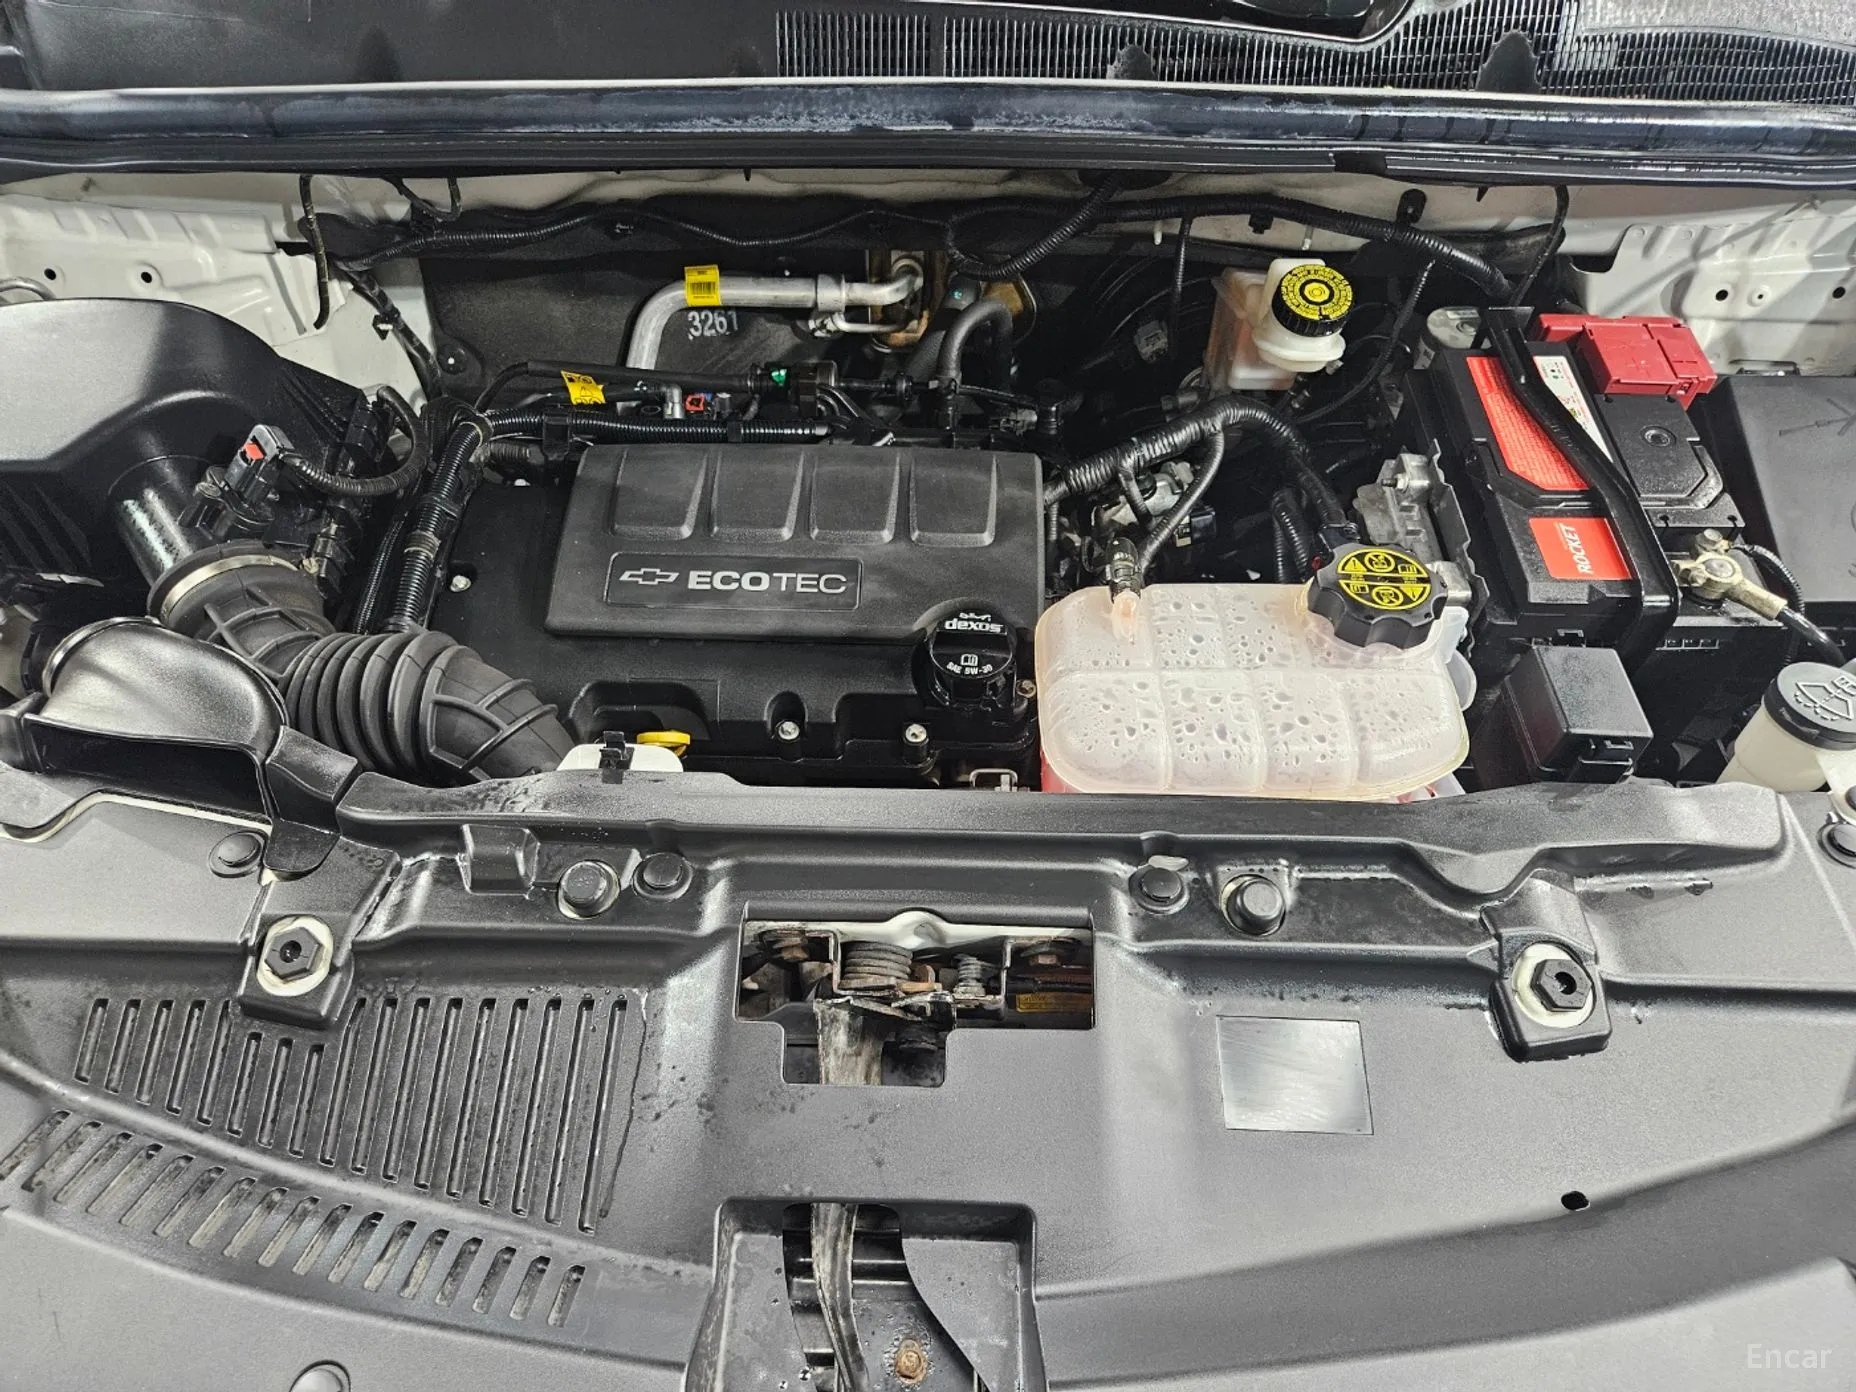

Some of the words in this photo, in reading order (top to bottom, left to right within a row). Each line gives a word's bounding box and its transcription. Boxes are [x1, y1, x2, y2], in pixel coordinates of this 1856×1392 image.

[1559, 522, 1594, 575] ROCKET
[687, 570, 848, 595] ECOTEC
[944, 618, 1004, 632] dexos
[946, 661, 962, 674] SAE
[964, 664, 993, 675] 5W-30
